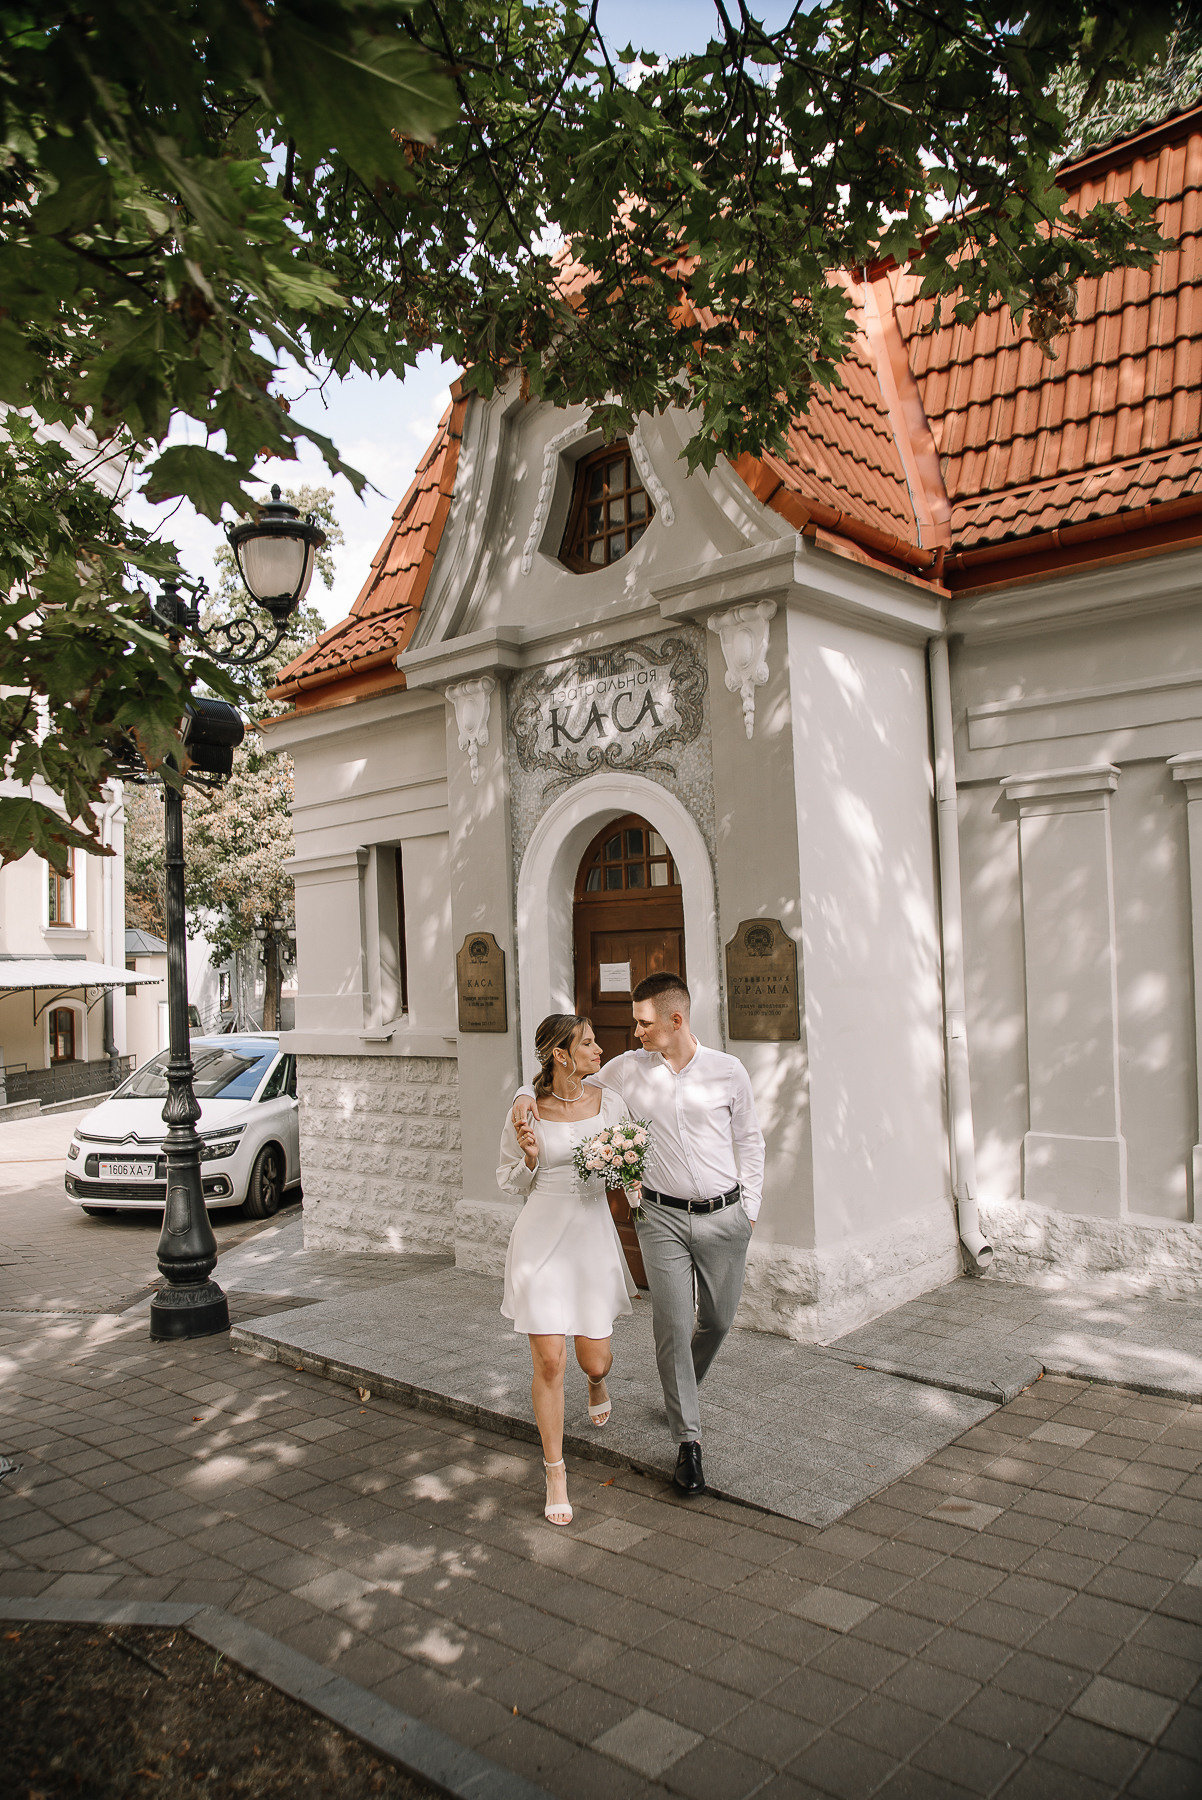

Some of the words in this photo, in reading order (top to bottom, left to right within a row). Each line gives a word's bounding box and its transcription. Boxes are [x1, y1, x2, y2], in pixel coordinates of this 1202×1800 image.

[550, 668, 657, 704] тэатральная
[545, 689, 664, 749] КАСА
[467, 979, 493, 988] КАСА
[734, 985, 790, 995] КРАМА
[109, 1164, 128, 1175] 1606
